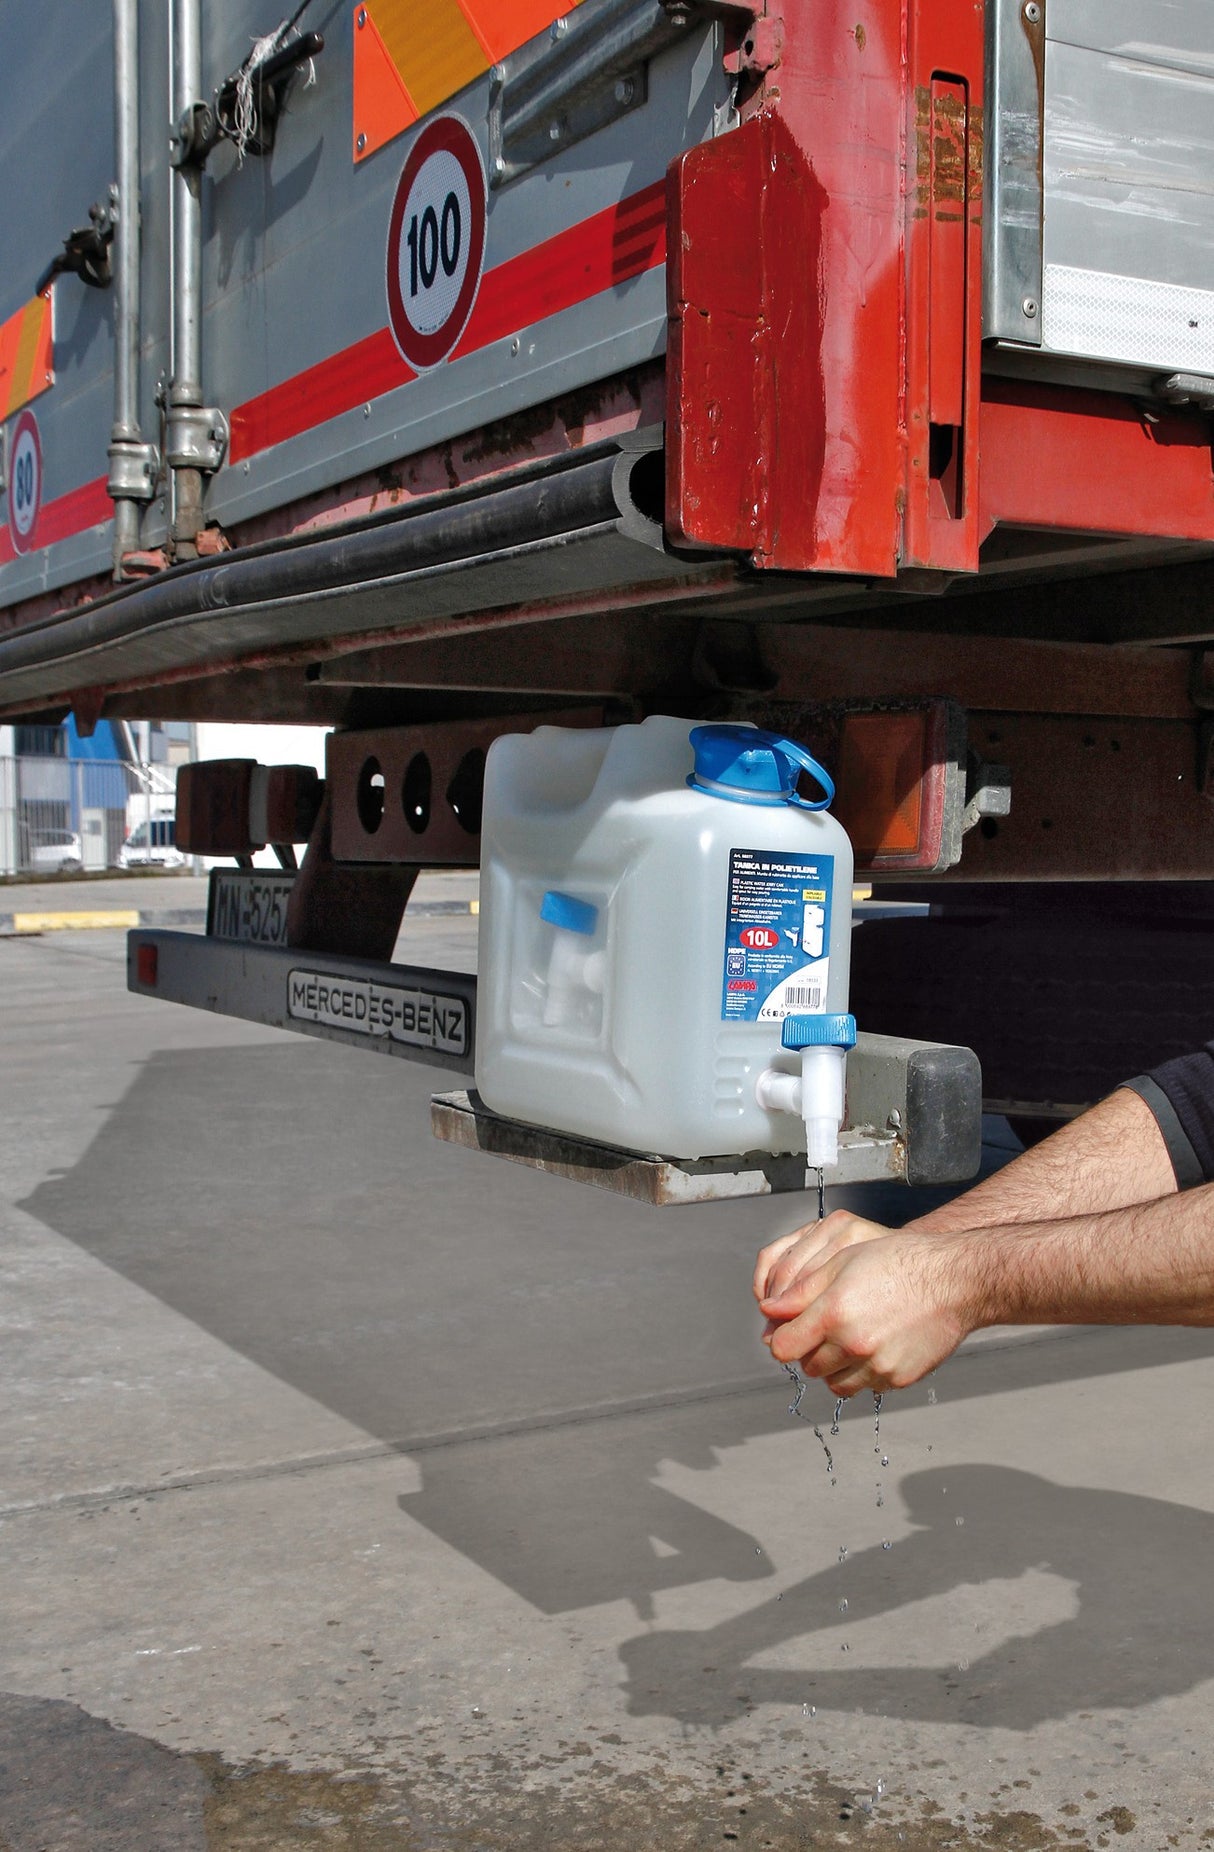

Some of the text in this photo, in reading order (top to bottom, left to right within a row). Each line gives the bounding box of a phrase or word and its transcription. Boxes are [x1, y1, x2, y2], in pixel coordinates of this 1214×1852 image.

[408, 191, 460, 297] 100
[17, 451, 33, 511] 80
[733, 862, 760, 870] TANICA
[771, 864, 818, 874] POLIETILENE
[747, 930, 772, 946] 10L
[728, 980, 756, 991] LAMPA
[292, 982, 462, 1042] MERCEDES-BENZ
